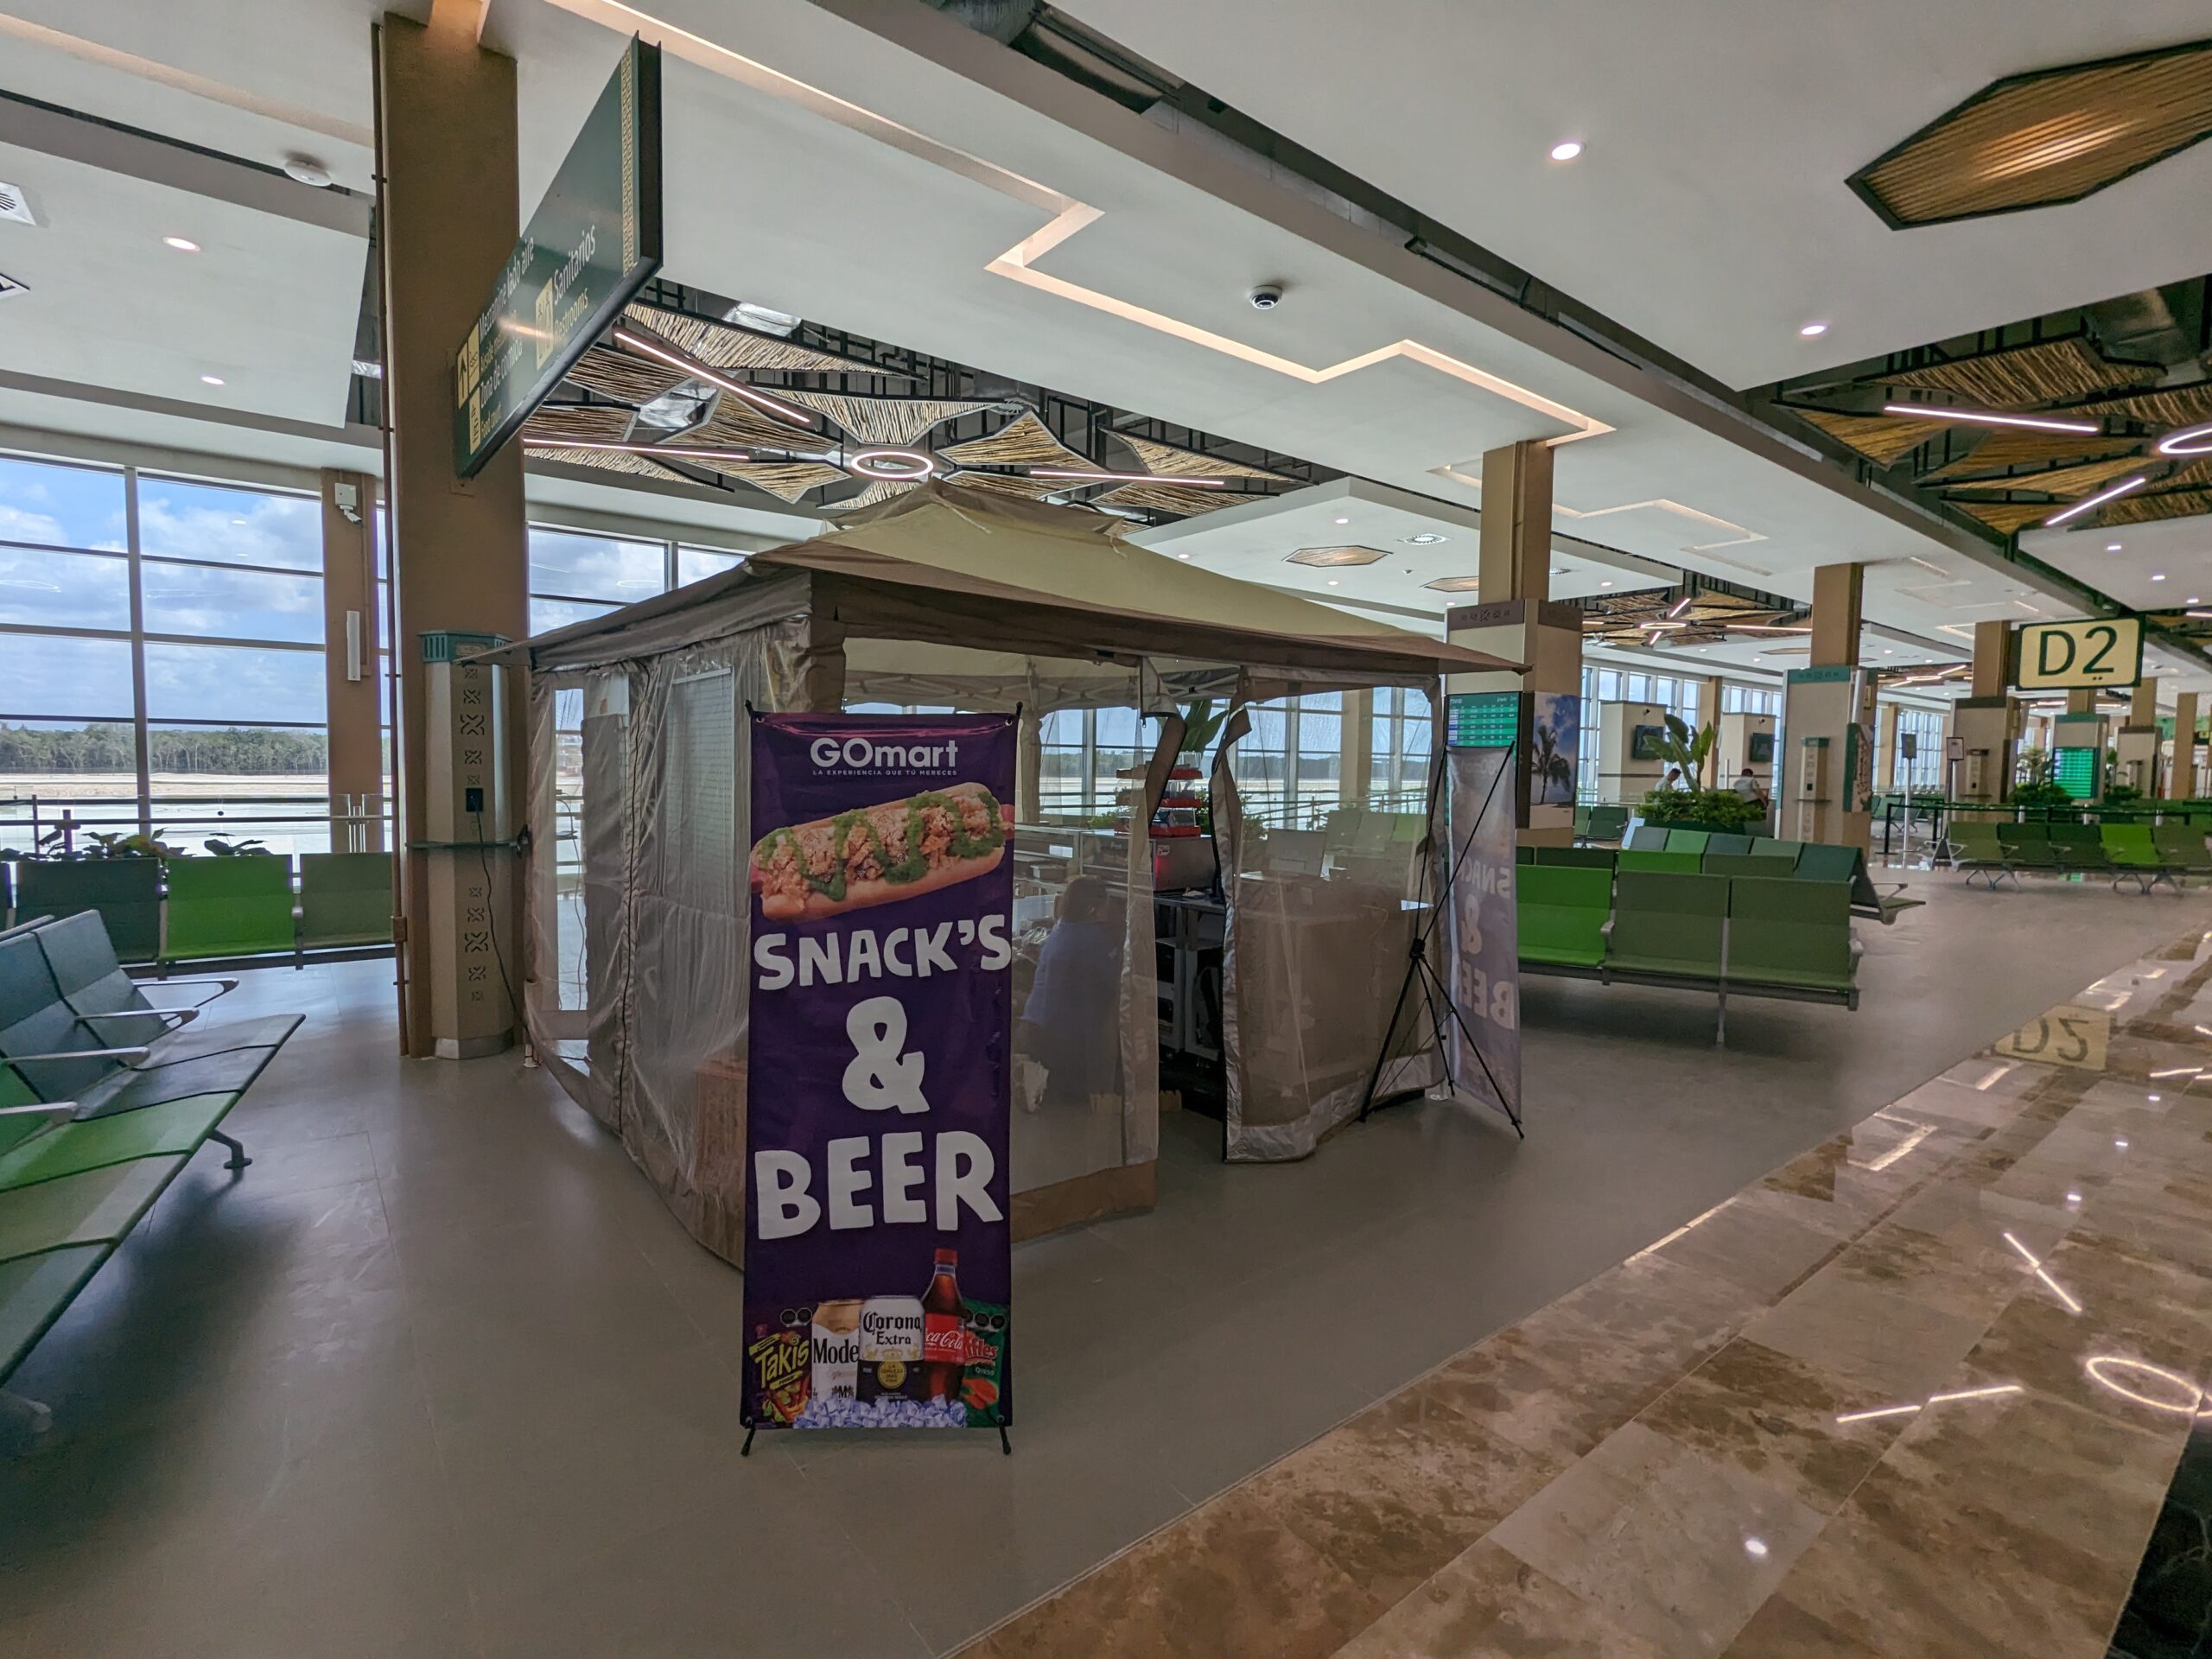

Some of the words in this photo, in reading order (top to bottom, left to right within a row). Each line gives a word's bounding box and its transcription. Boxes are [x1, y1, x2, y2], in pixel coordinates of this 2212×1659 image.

[554, 225, 595, 306] Sanitarios
[554, 287, 588, 340] Restrooms
[2038, 626, 2118, 677] D2
[810, 737, 958, 767] GOmart
[753, 914, 1012, 990] SNACK'S
[842, 995, 930, 1114] &
[754, 1130, 1004, 1240] BEER
[863, 1311, 922, 1335] Corona
[876, 1331, 912, 1345] Extra
[754, 1336, 810, 1389] Takis
